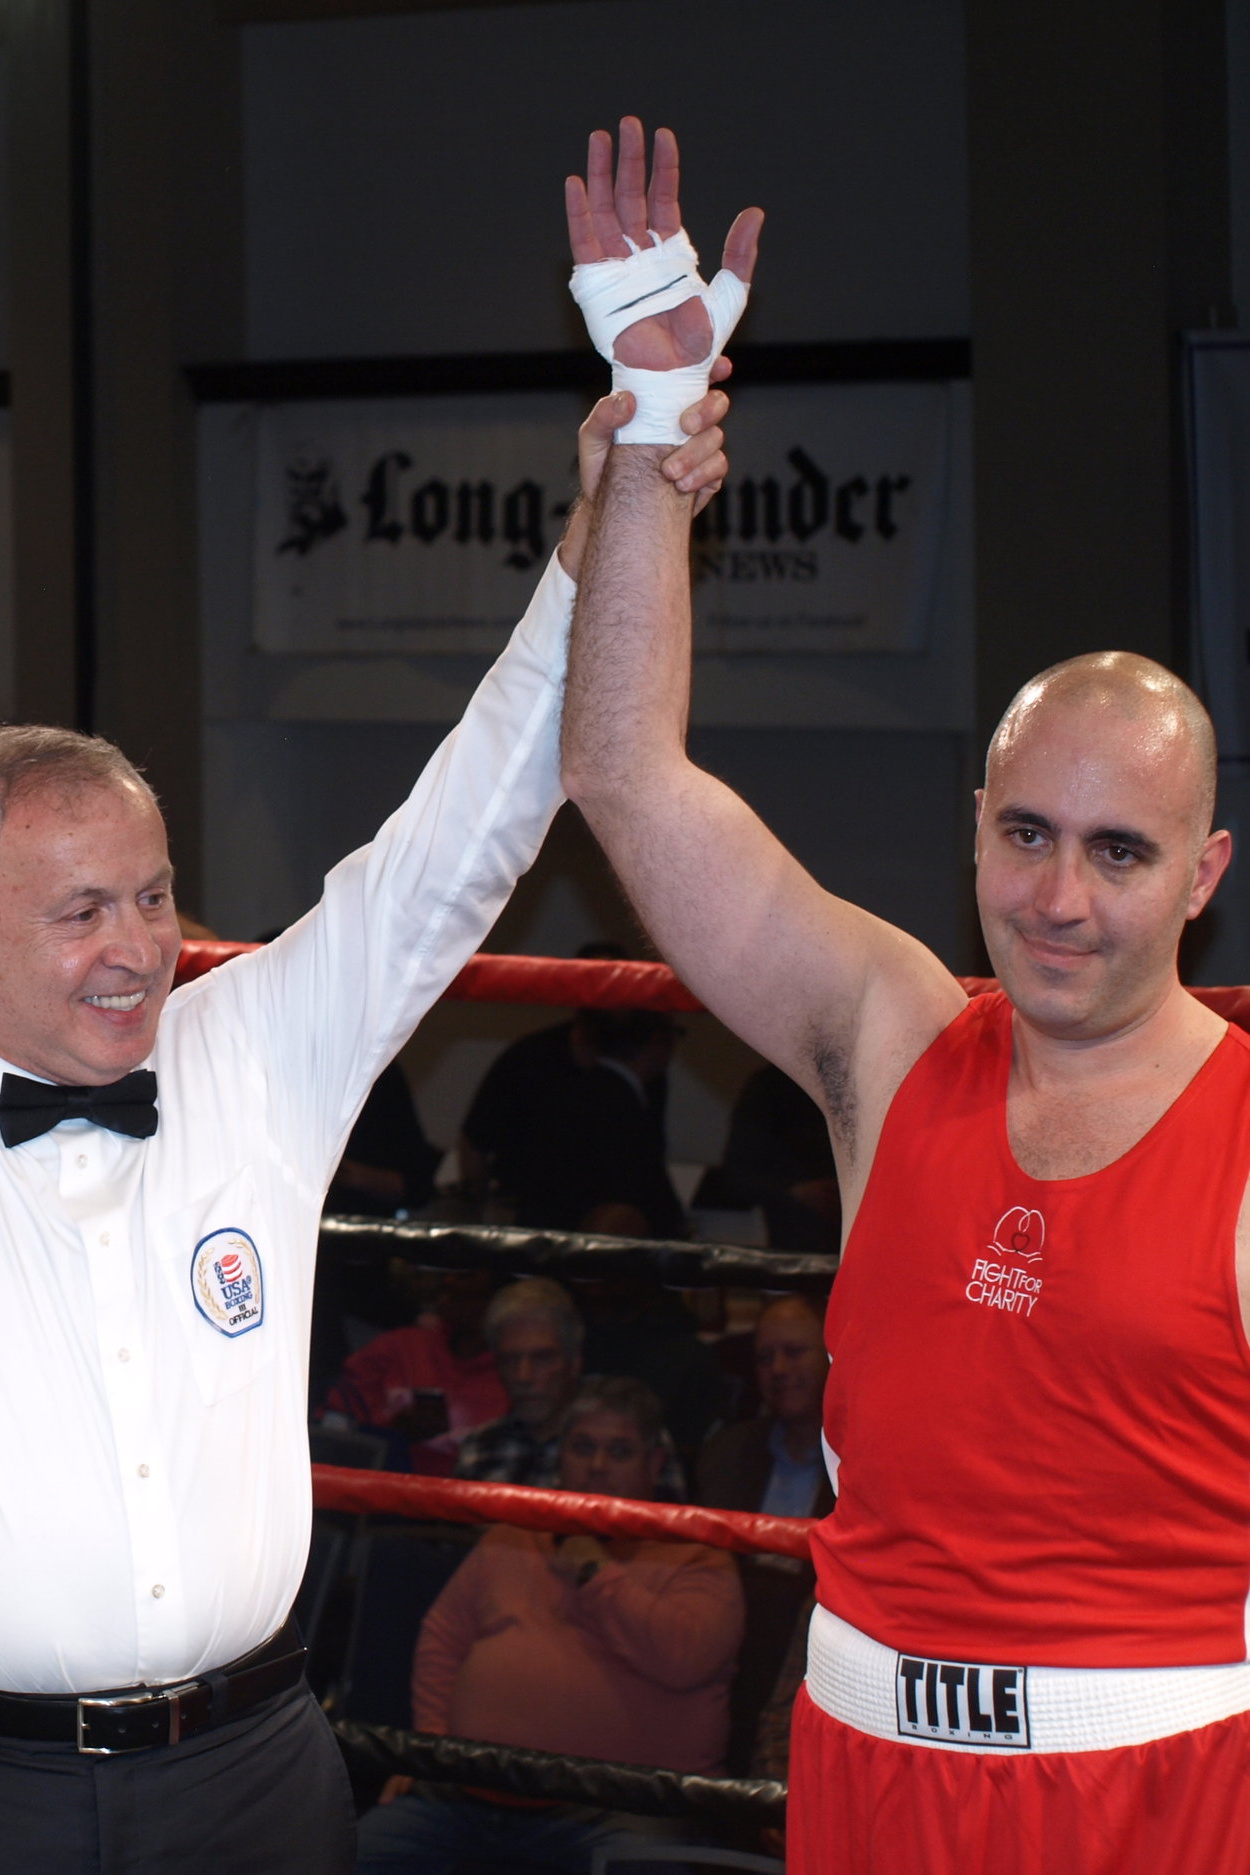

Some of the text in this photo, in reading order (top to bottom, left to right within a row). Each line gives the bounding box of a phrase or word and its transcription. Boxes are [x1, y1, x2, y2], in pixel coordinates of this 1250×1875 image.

[362, 444, 913, 569] Long-ander
[695, 551, 818, 582] NEWS
[221, 1279, 251, 1300] USA
[971, 1258, 1043, 1294] FIGHT FOR
[225, 1291, 252, 1310] BOXING
[965, 1281, 1038, 1318] CHARITY
[229, 1306, 259, 1326] OFFICIAL
[900, 1658, 1020, 1733] TITLE
[911, 1724, 1014, 1740] BOXING
